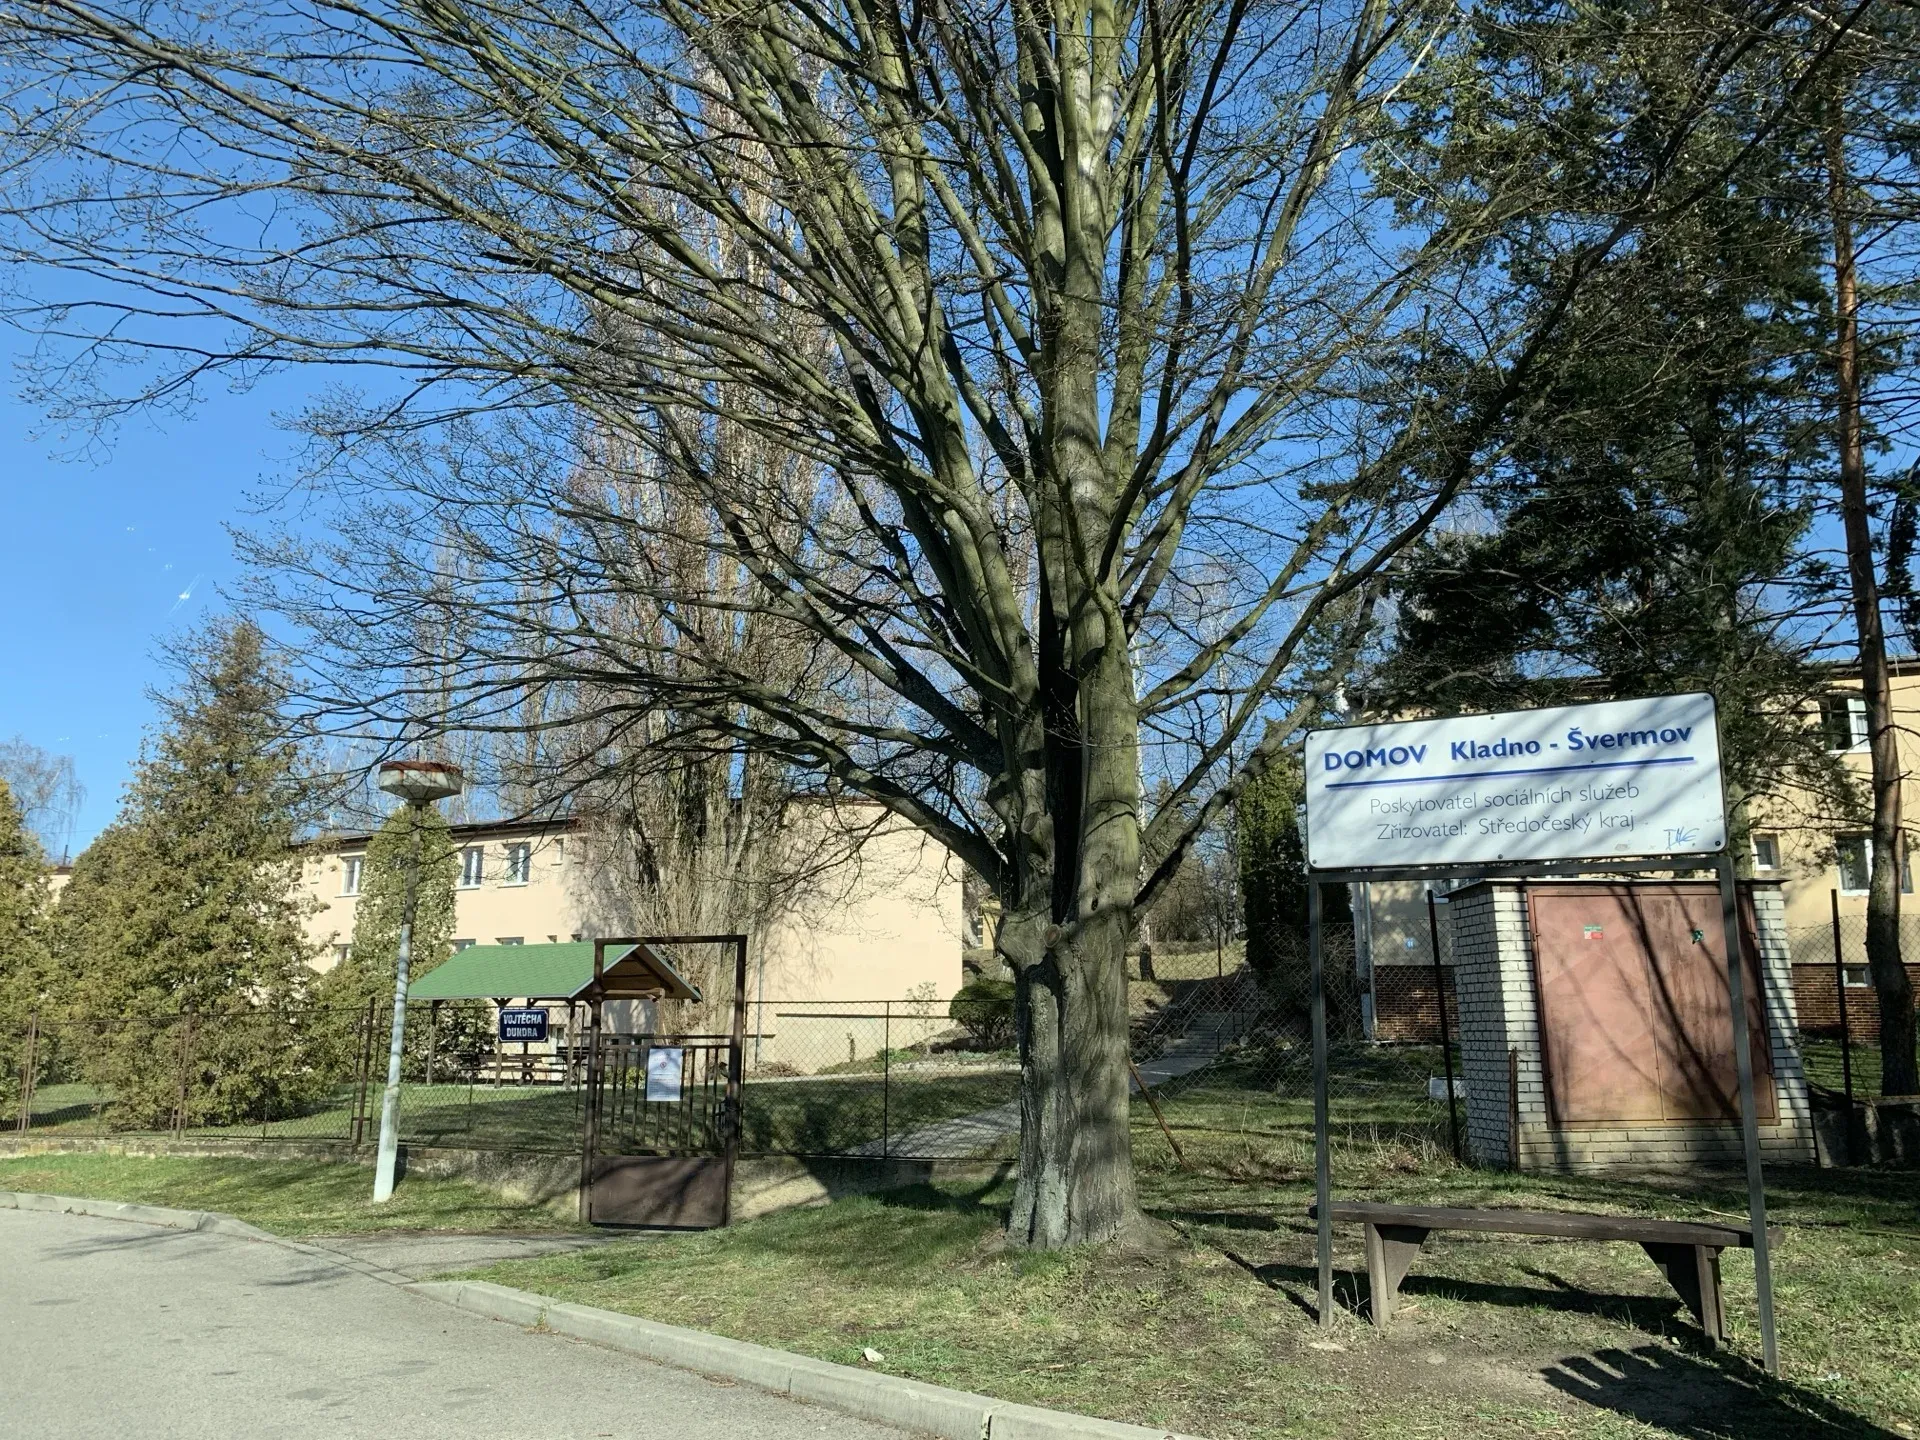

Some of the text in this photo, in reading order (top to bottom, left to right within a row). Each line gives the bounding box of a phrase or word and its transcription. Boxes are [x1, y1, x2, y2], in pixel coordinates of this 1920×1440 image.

[1325, 745, 1426, 770] DOMOV
[1451, 738, 1540, 760] Kladno
[1566, 727, 1691, 750] Švermov
[1371, 780, 1639, 817] Poskytovatel sociálních služeb
[1377, 809, 1634, 841] Zřizovatel: Středočeský kraj
[504, 1012, 542, 1024] VOJTĚCHA
[506, 1027, 538, 1037] DUNDRA
